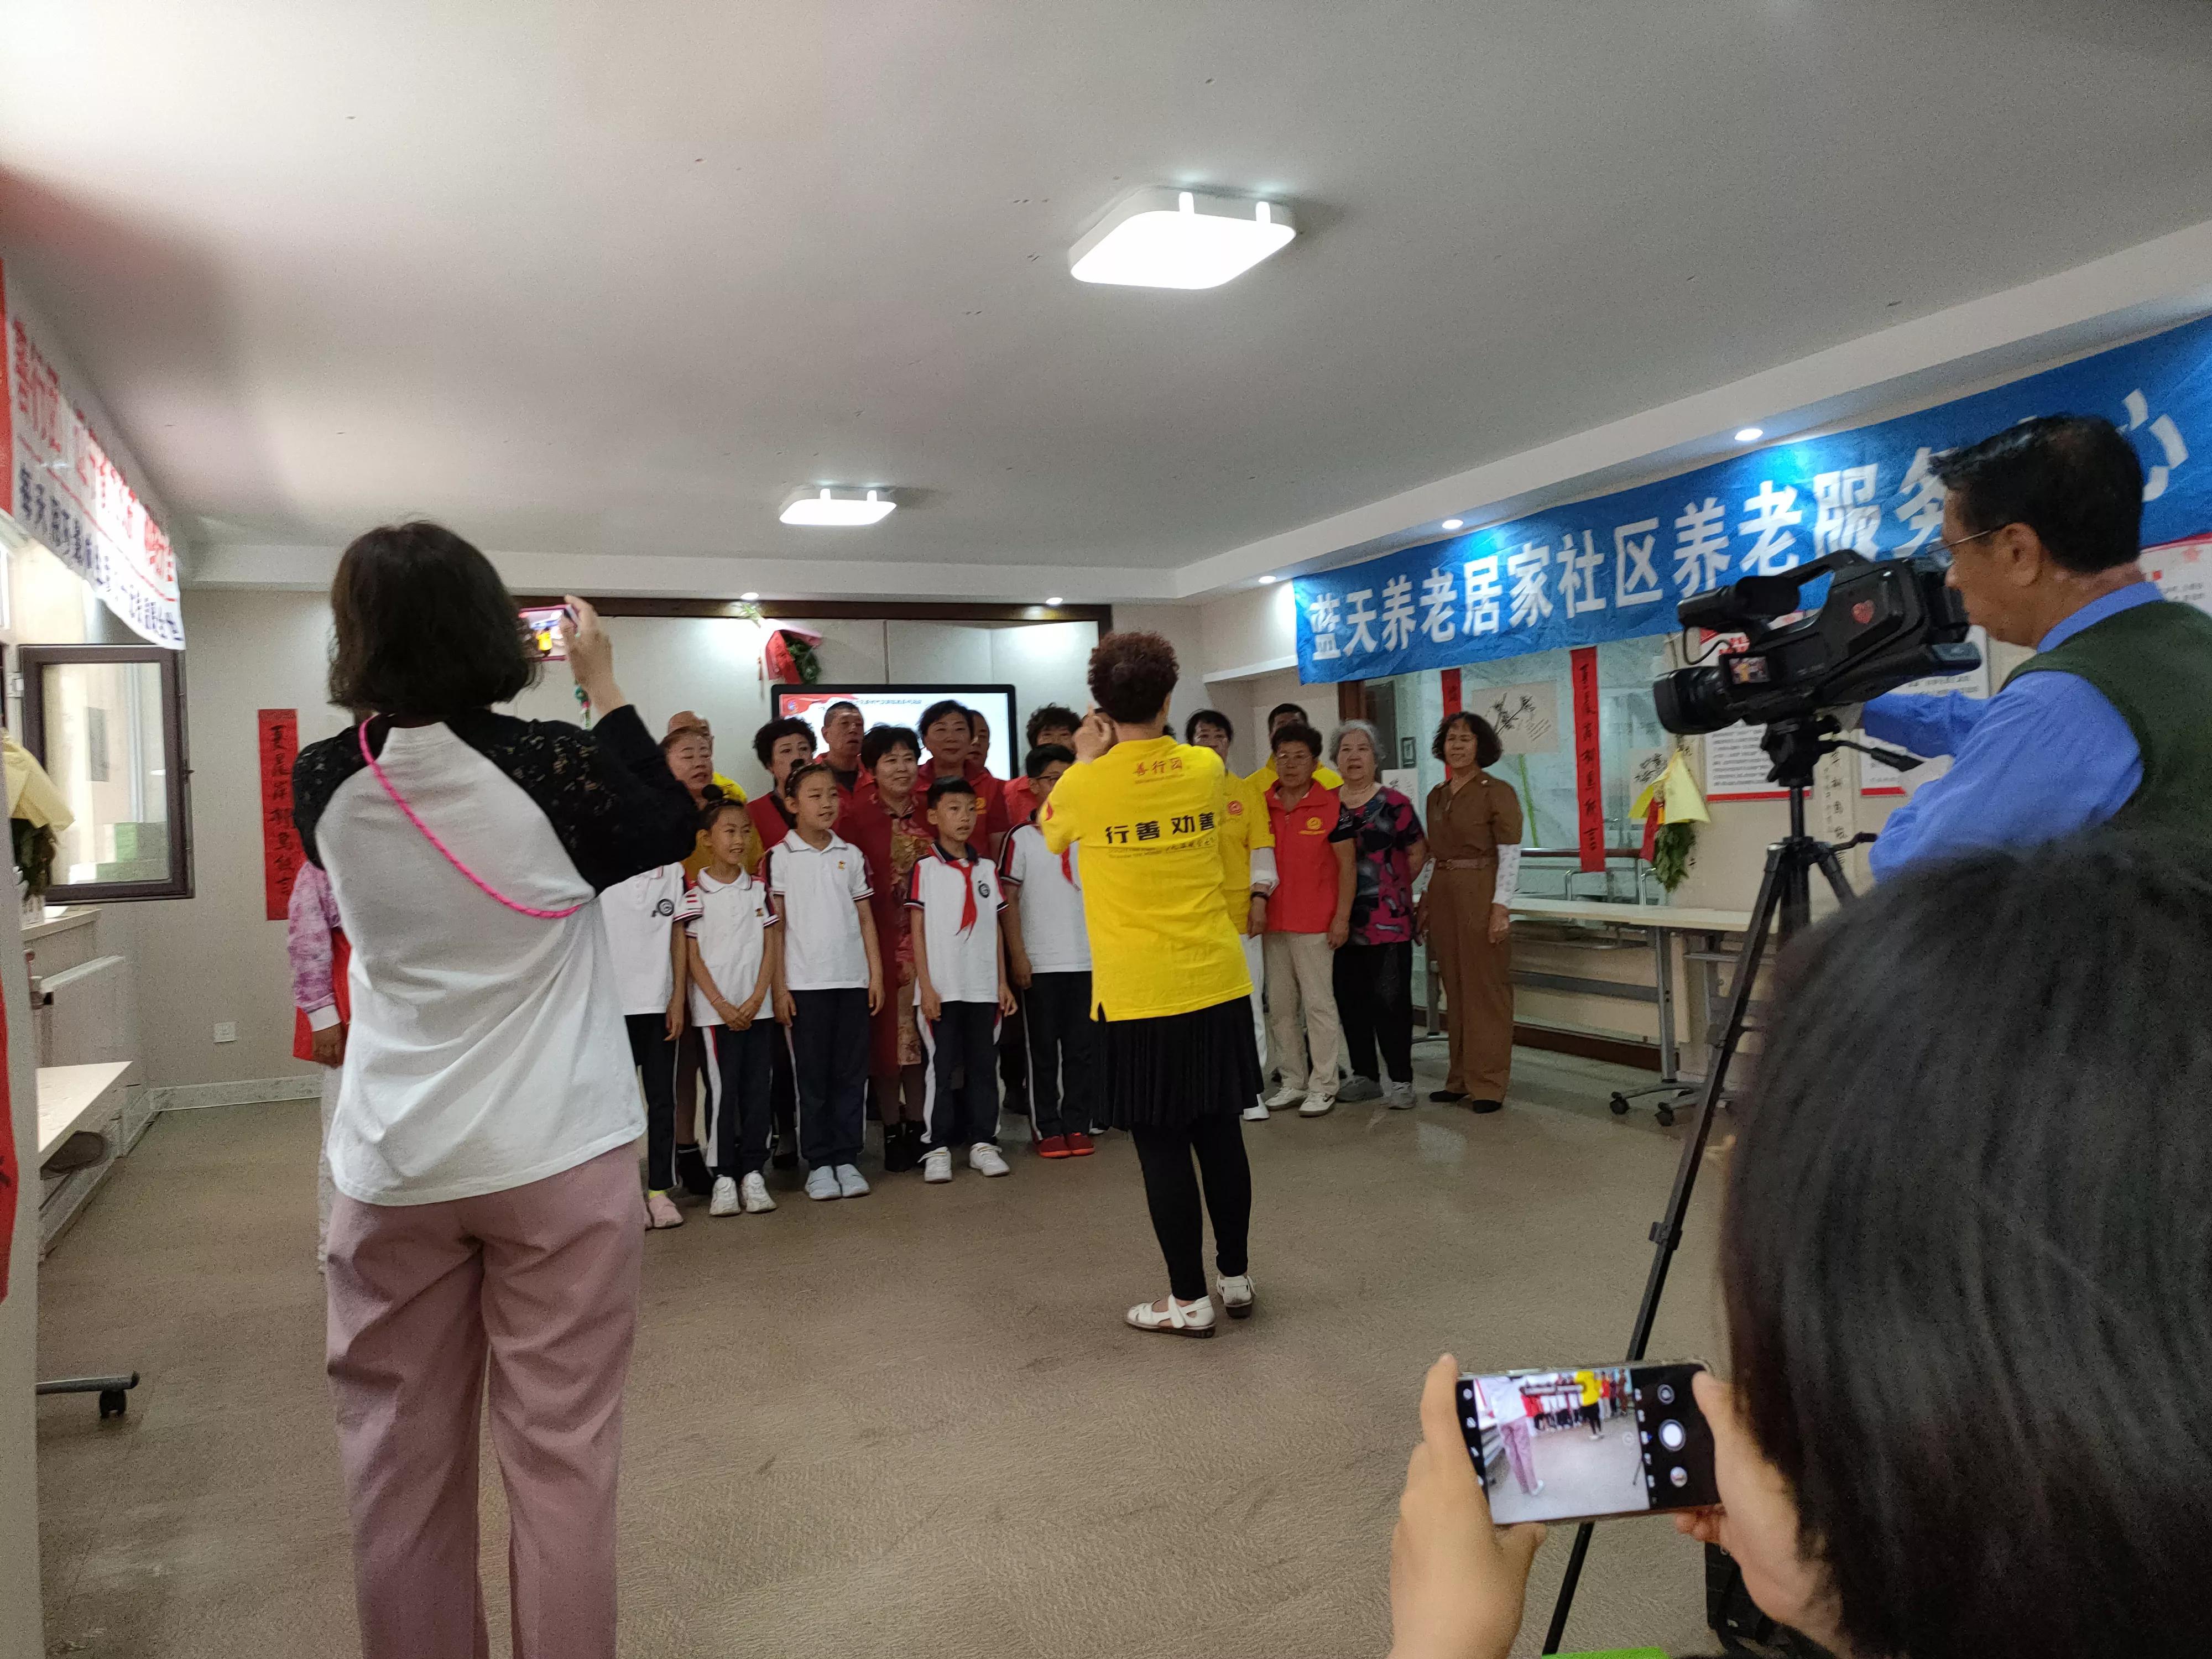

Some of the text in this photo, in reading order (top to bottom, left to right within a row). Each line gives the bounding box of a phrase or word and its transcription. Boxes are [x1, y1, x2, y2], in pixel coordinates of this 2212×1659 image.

[1309, 388, 2188, 661] 蓝天养老居家社区养老服务心
